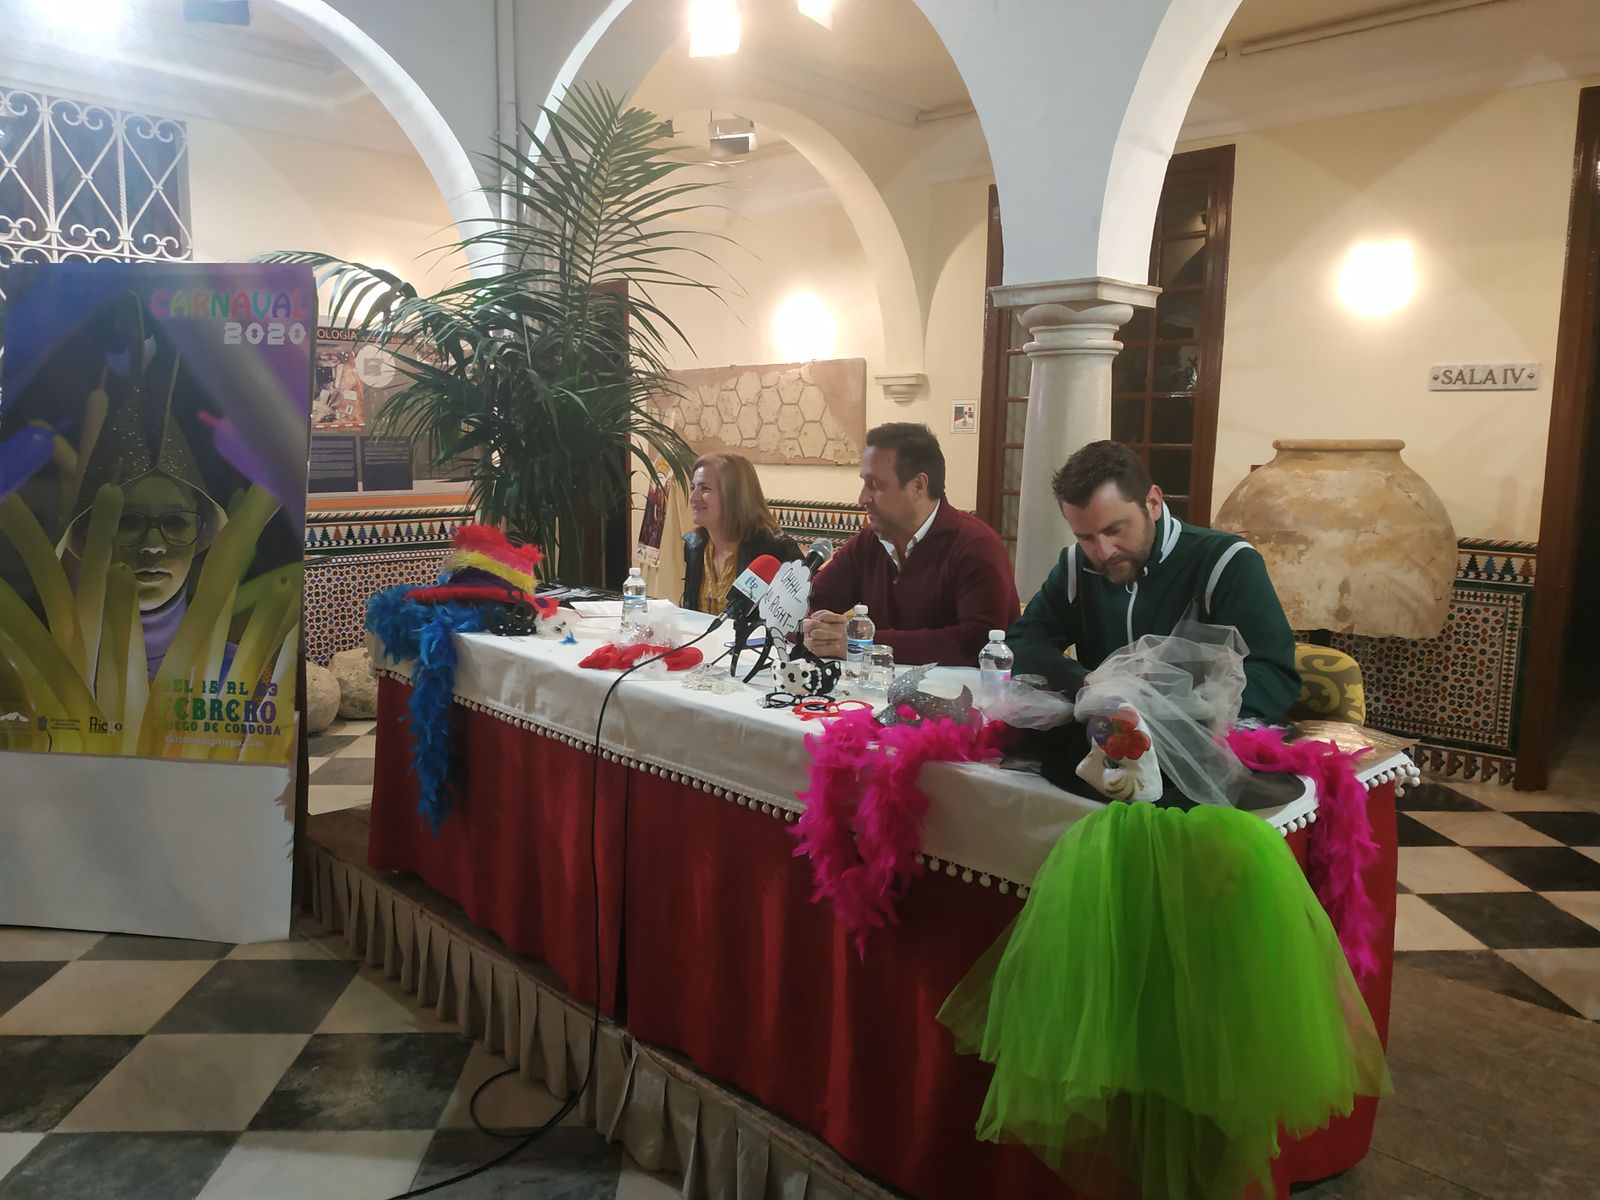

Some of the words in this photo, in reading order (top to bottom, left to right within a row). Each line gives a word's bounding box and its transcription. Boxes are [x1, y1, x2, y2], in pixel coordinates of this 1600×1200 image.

[151, 289, 306, 319] CARNAVAL
[224, 322, 306, 345] 2020
[1441, 368, 1497, 385] SALA
[1502, 368, 1525, 384] IV
[202, 680, 219, 693] 15
[227, 681, 249, 695] AL
[204, 722, 219, 733] DE
